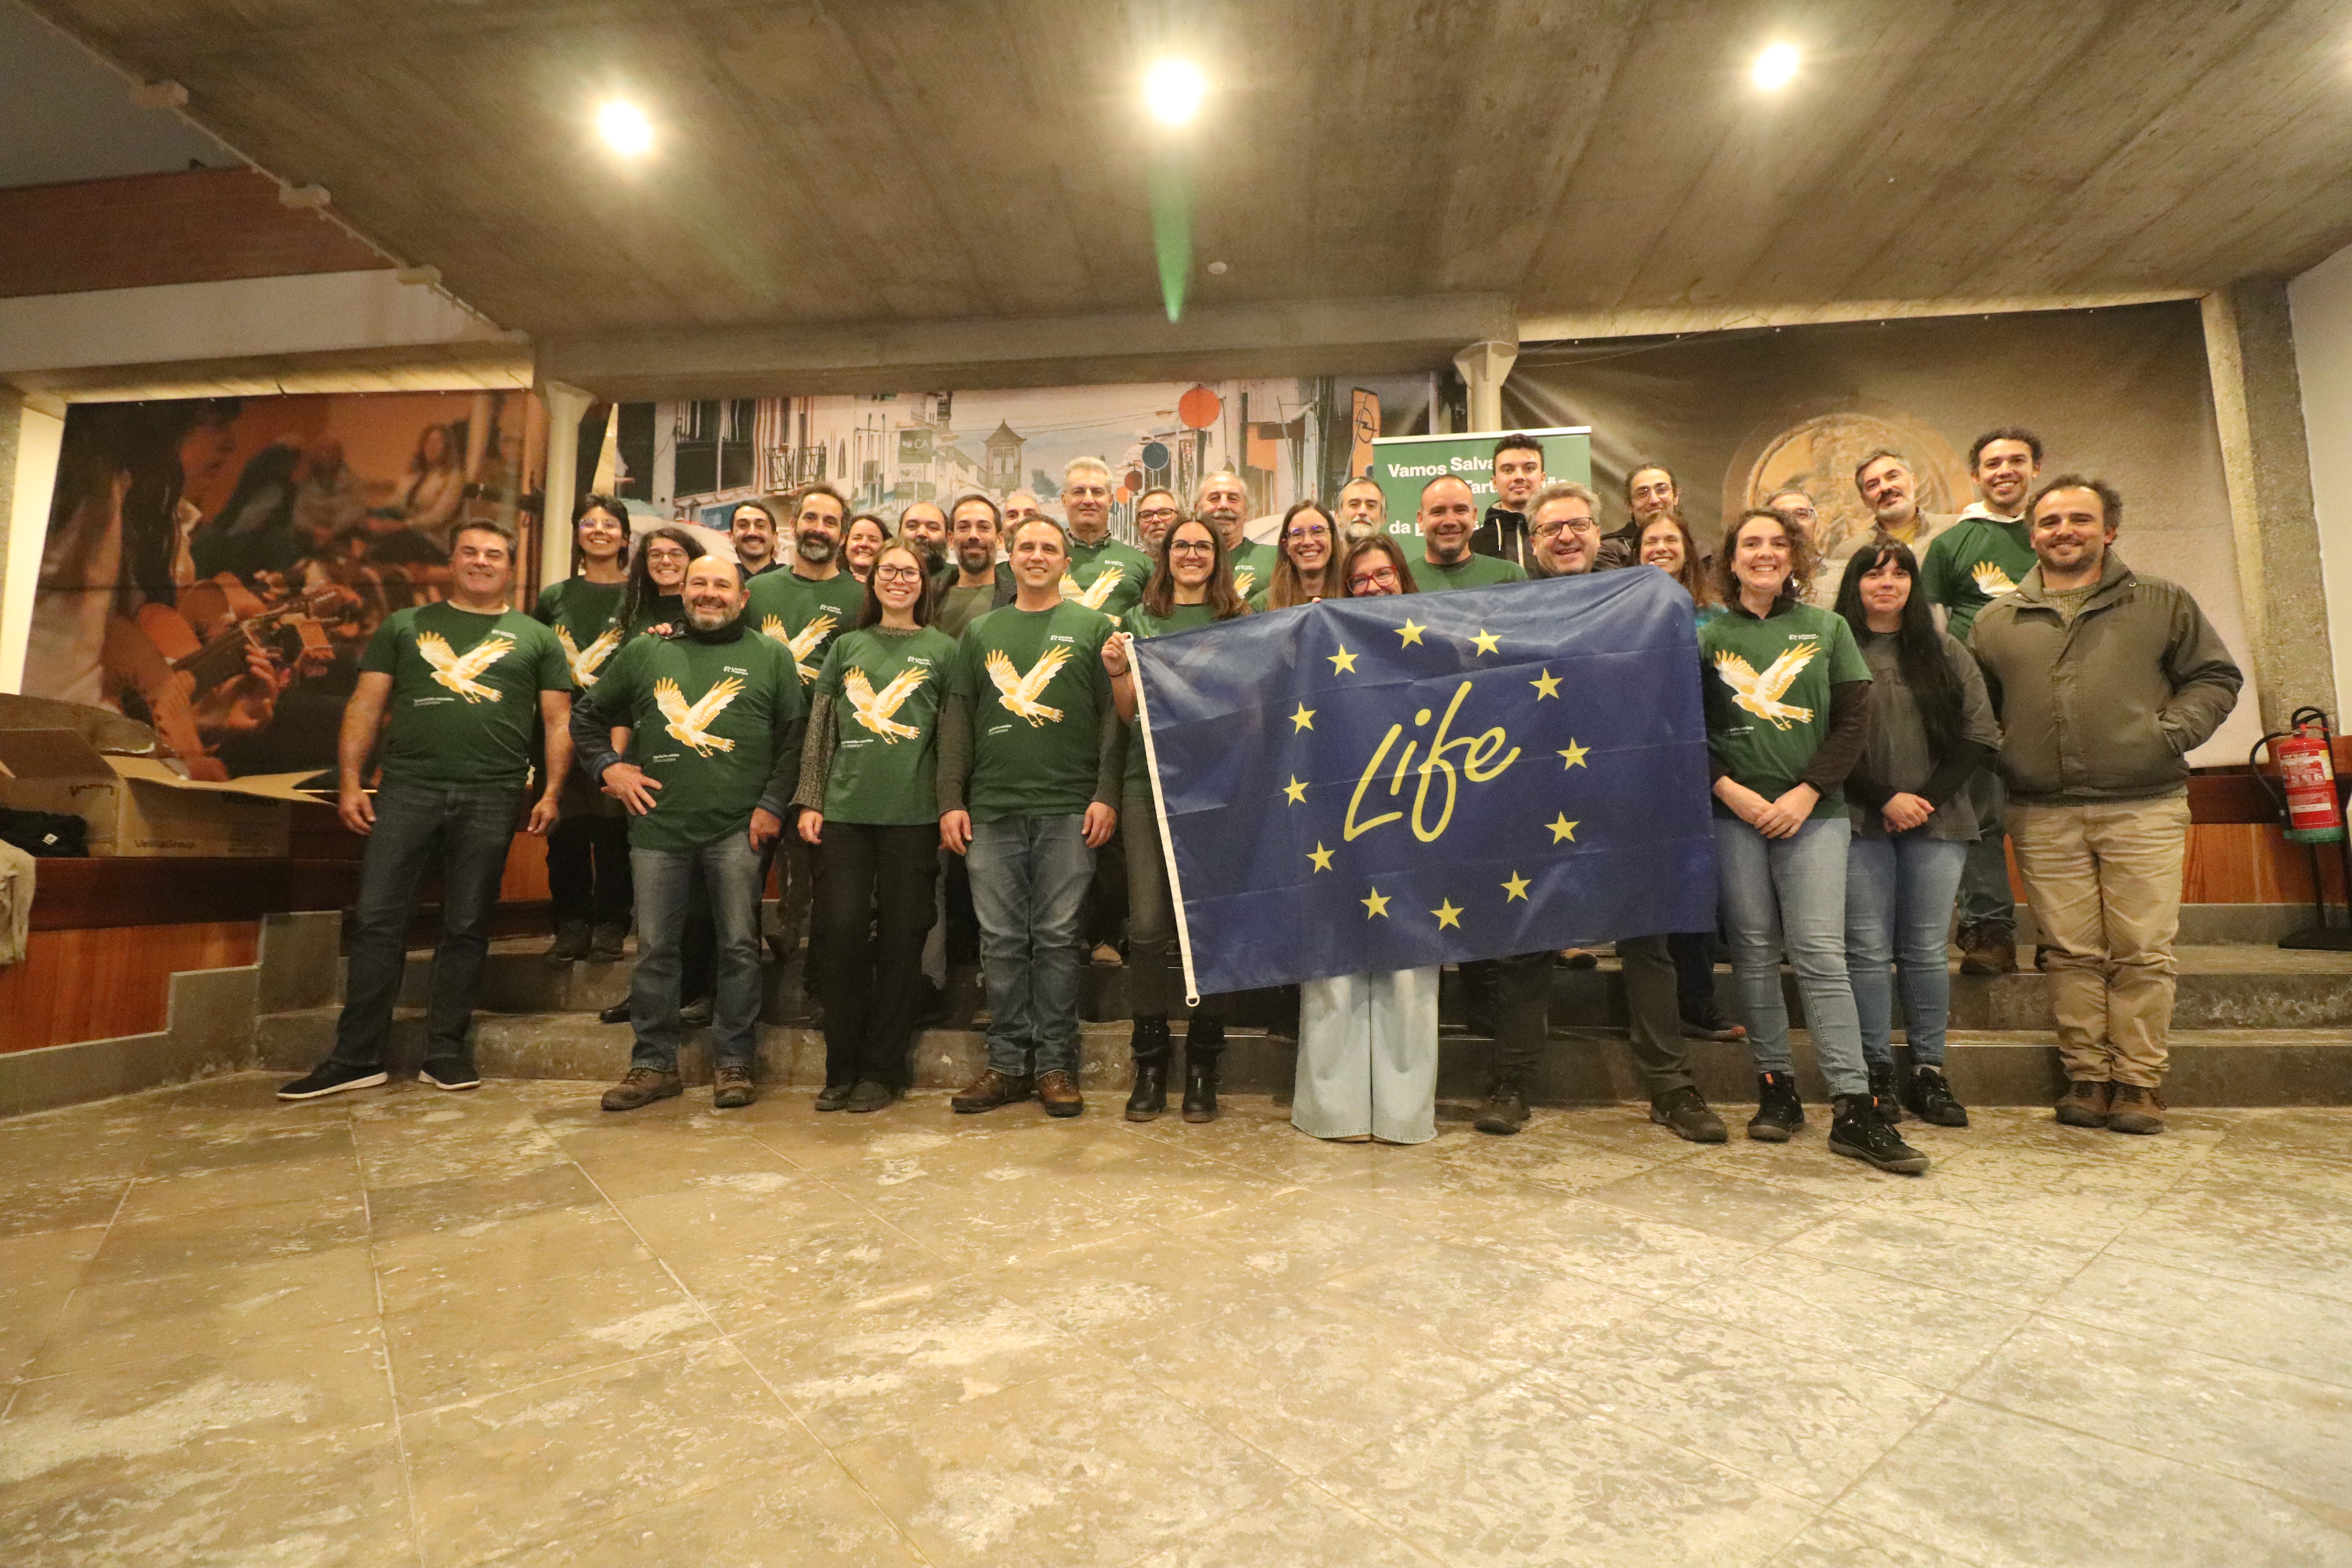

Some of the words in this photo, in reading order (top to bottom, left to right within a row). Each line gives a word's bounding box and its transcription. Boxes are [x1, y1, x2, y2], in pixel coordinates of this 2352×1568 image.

[915, 439, 928, 449] CA
[1387, 464, 1447, 477] Vamos
[1450, 456, 1494, 471] Salva
[1389, 520, 1411, 534] da
[1343, 681, 1521, 842] Life
